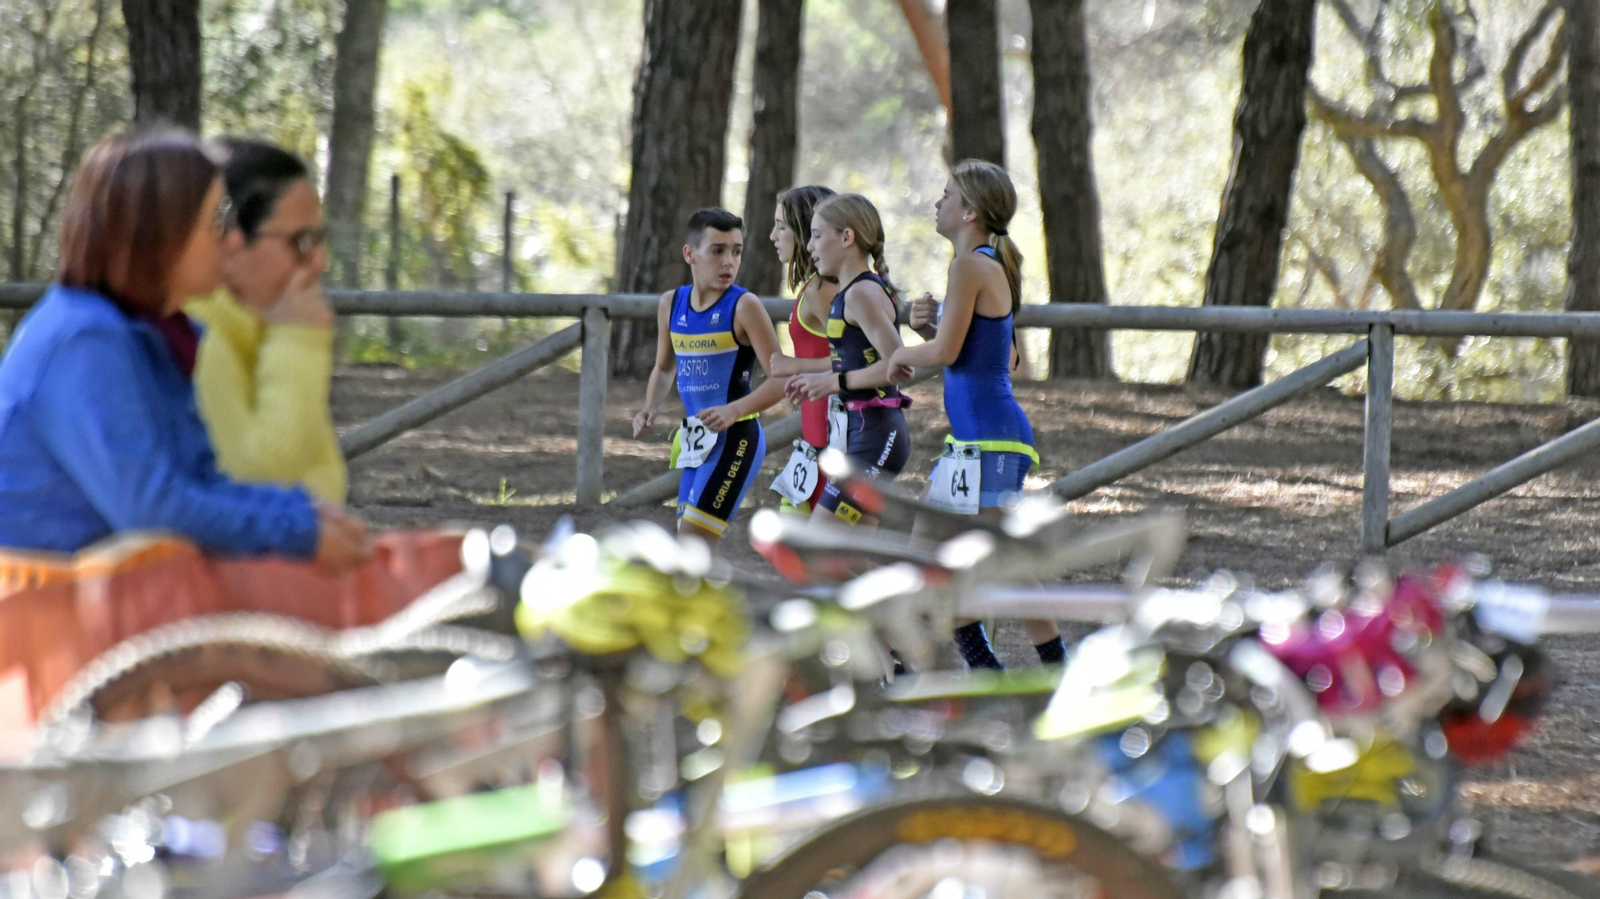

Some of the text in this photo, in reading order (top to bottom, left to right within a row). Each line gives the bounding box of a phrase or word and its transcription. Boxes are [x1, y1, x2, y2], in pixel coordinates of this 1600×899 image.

[689, 339, 718, 349] CORIA
[678, 358, 709, 377] CASTRO
[877, 430, 897, 467] DENTAL
[712, 439, 748, 509] CORIA DEL RIO
[793, 462, 808, 494] 62
[951, 468, 970, 498] 64
